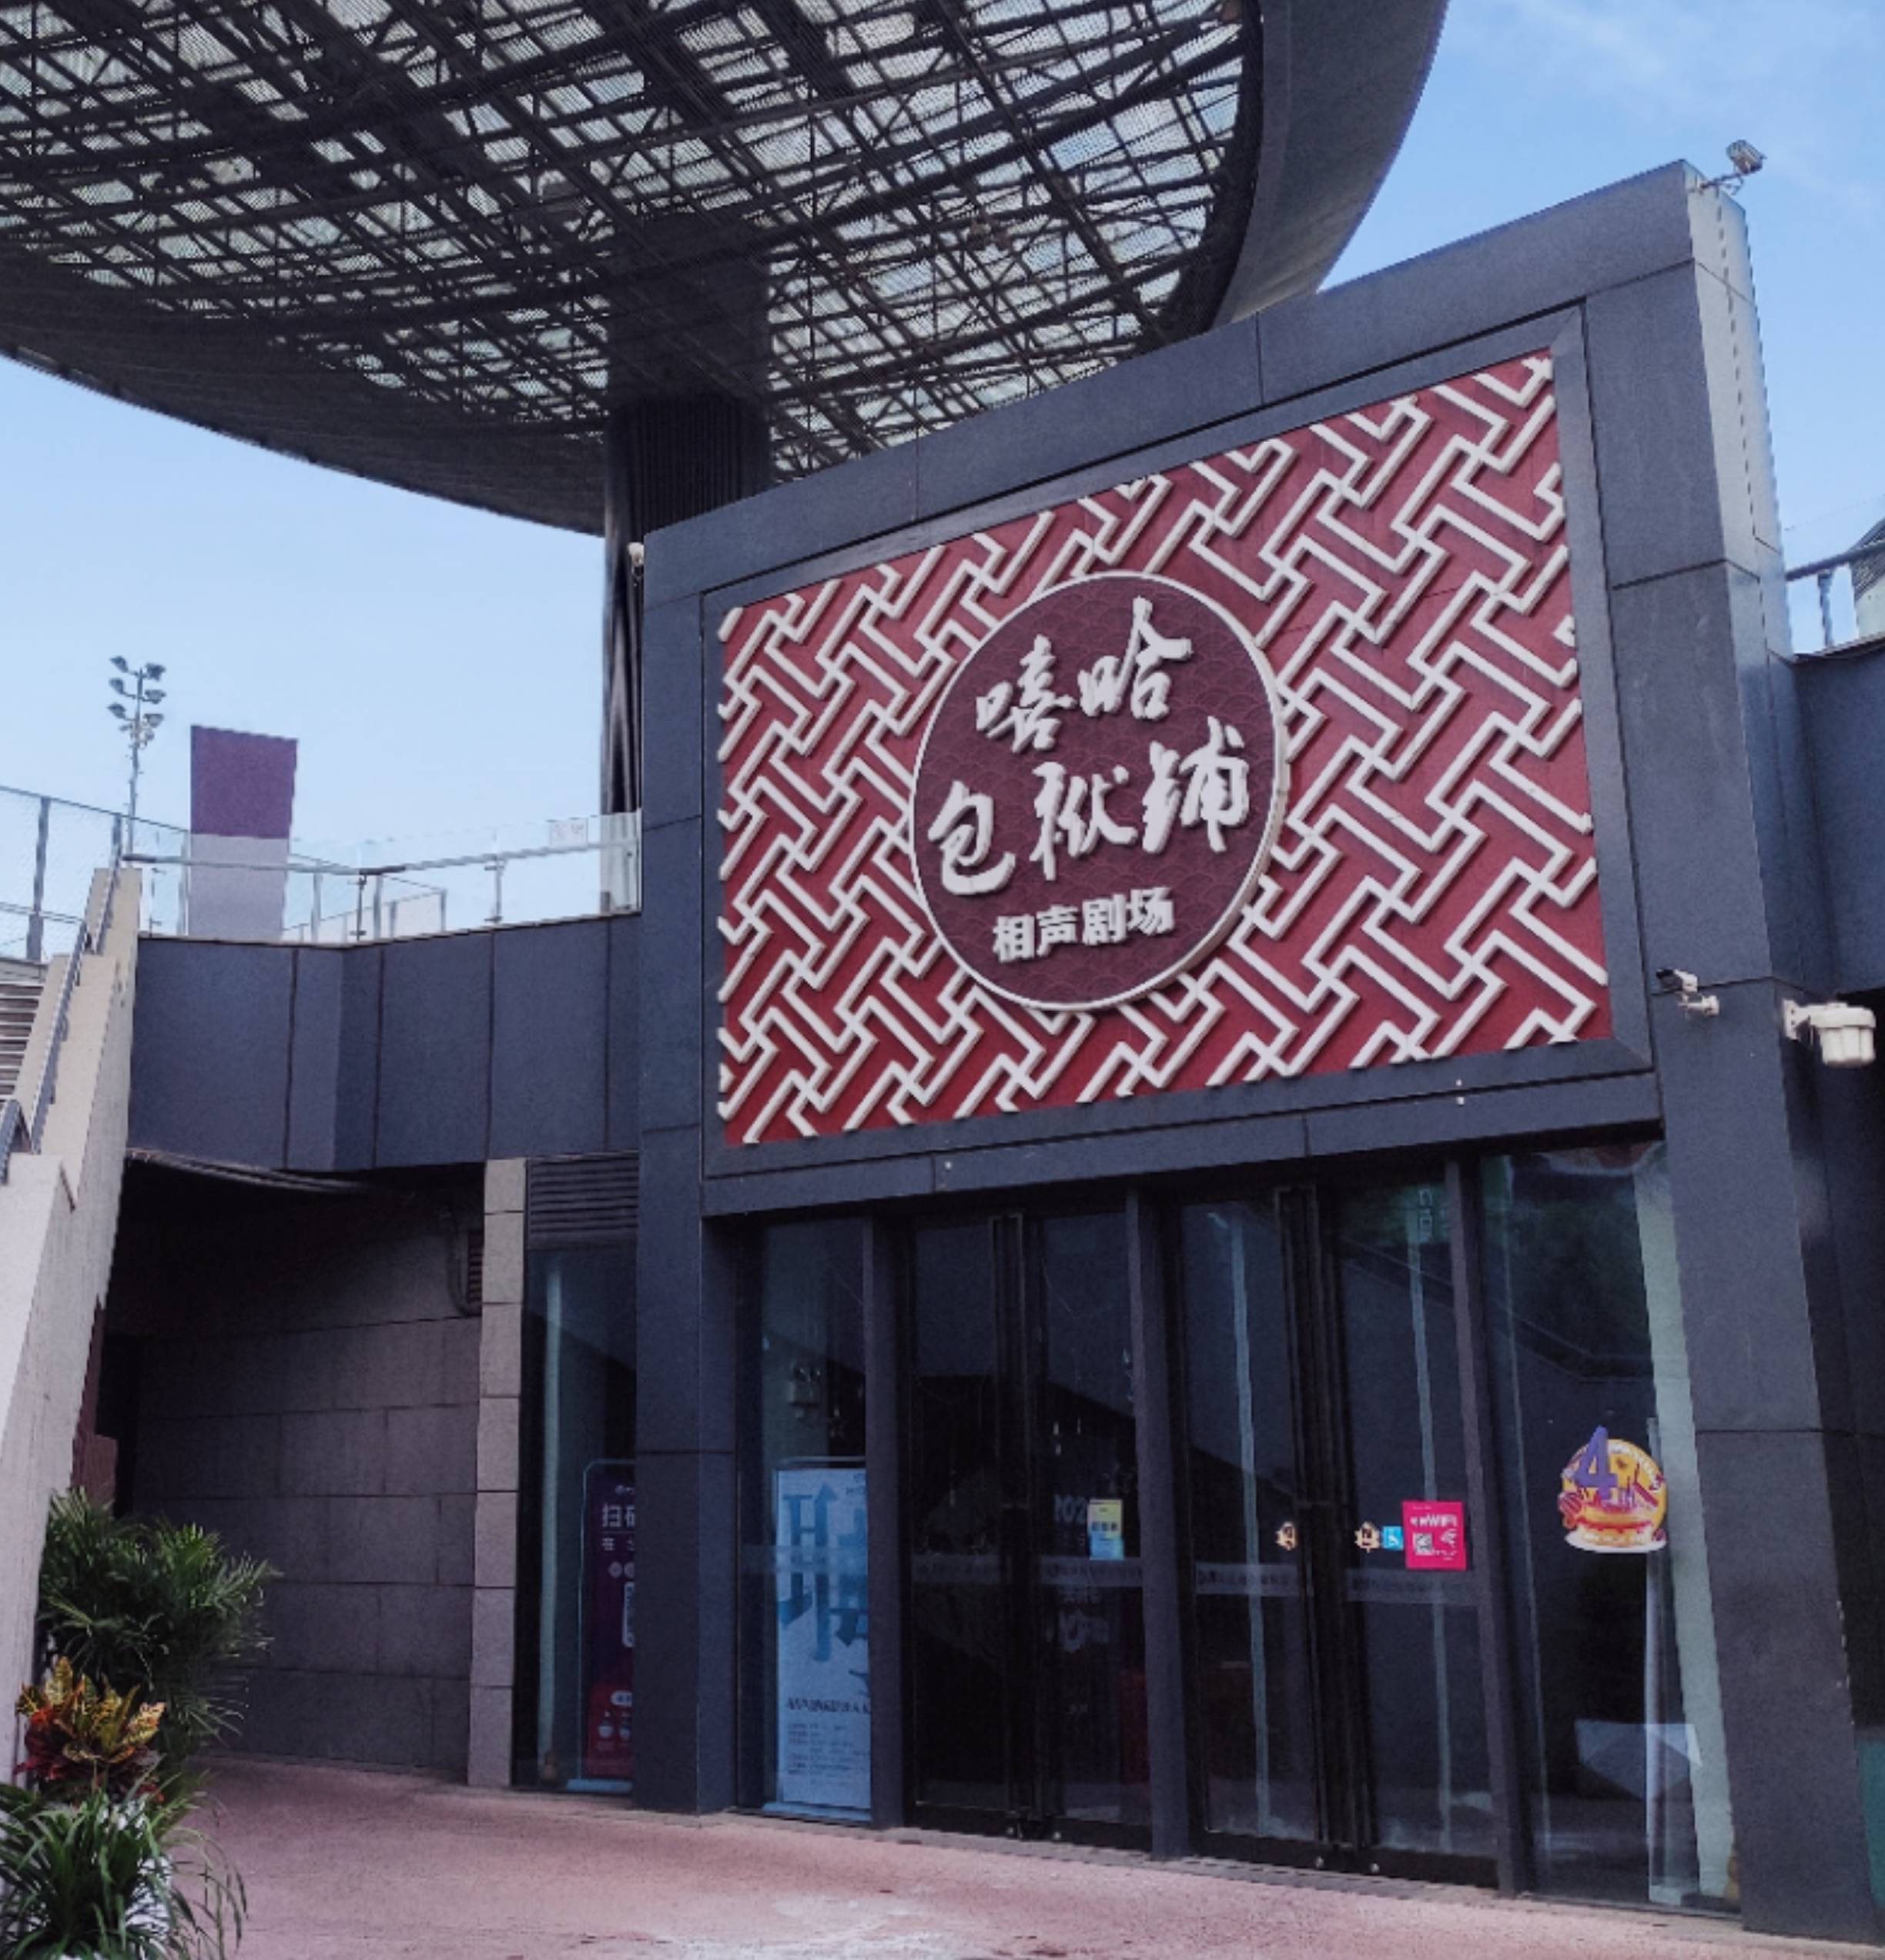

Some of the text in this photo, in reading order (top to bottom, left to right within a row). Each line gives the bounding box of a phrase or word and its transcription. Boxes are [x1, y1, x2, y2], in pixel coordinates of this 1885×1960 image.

[975, 596, 1192, 753] 嘻哈
[993, 886, 1174, 963] 相声剧场
